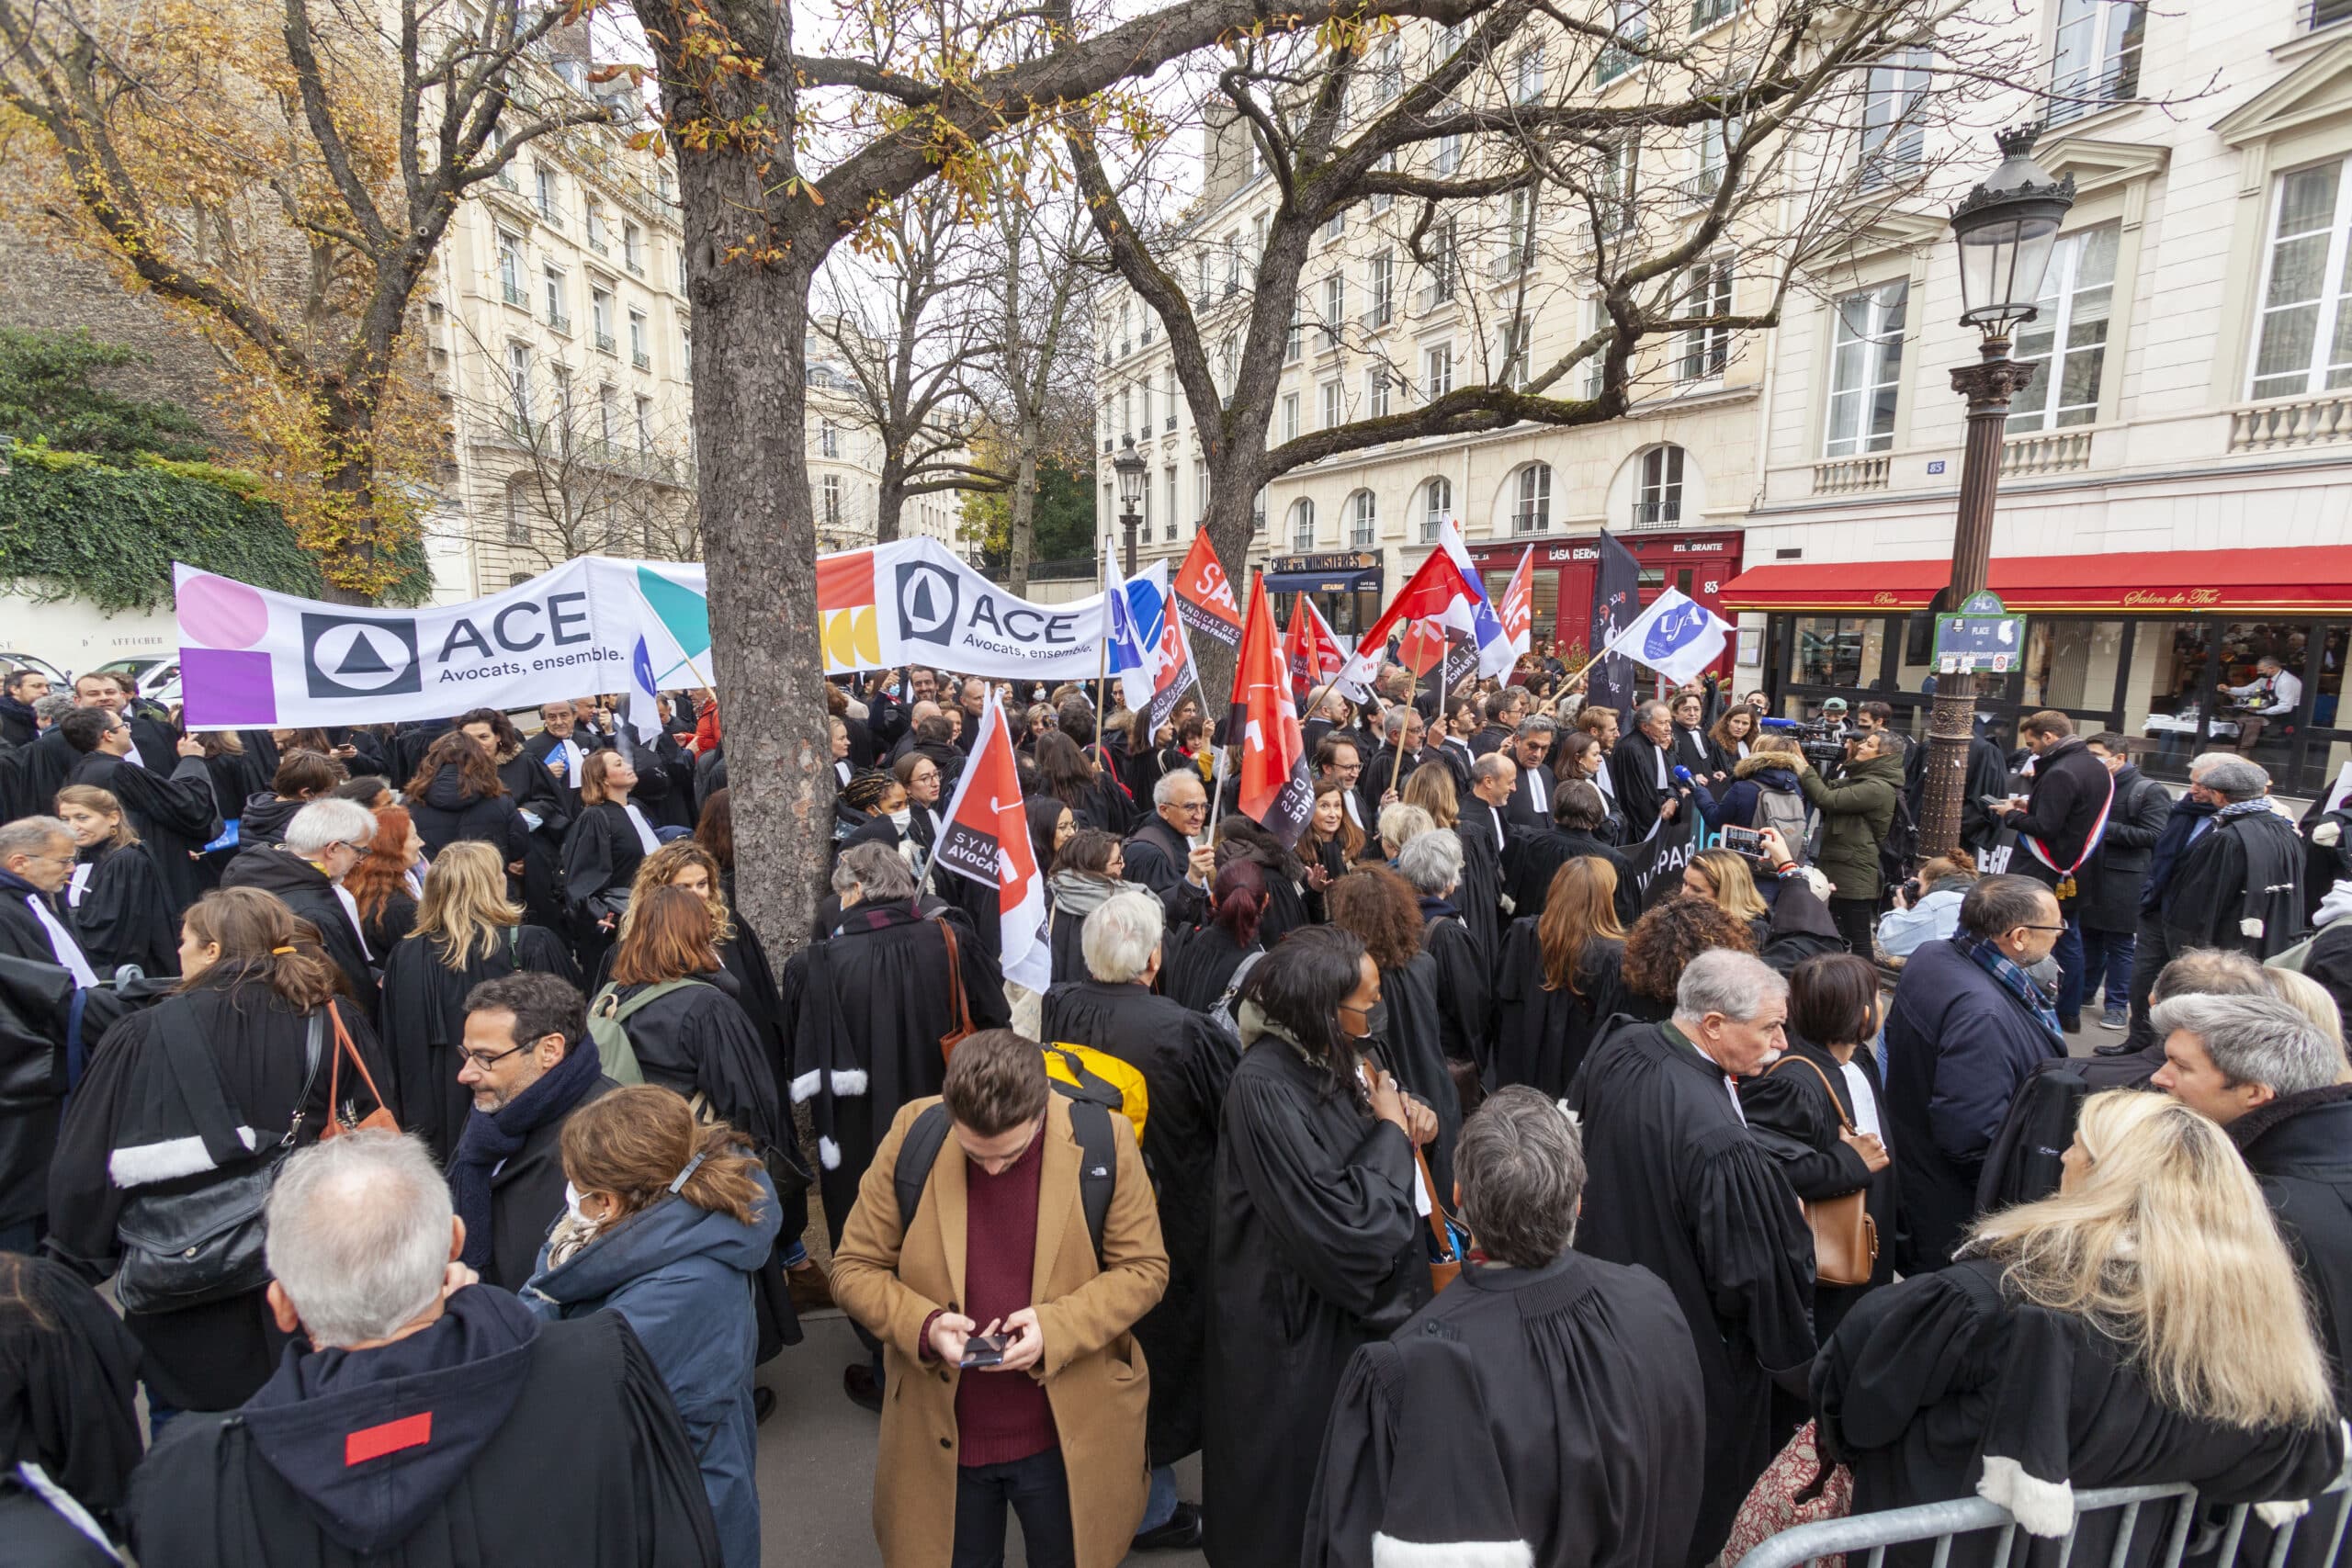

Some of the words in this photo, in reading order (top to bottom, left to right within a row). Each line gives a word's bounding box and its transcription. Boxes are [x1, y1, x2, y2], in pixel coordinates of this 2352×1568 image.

[1929, 462, 1943, 473] 85
[1874, 592, 1897, 604] Bar
[2124, 590, 2167, 606] Salon
[2168, 592, 2185, 604] de
[2187, 589, 2222, 604] Thé
[437, 592, 591, 662] ACE
[967, 594, 1080, 644] ACE
[1177, 599, 1220, 627] SYNDICAT
[1221, 625, 1241, 640] DES
[1209, 627, 1237, 647] FRANCE
[1972, 626, 1991, 636] PLACE
[111, 637, 163, 646] AFFICHER
[963, 634, 1026, 659] Avocats,
[1030, 645, 1092, 659] ensemble.
[439, 661, 527, 683] Avocats,
[532, 646, 625, 671] ensemble.
